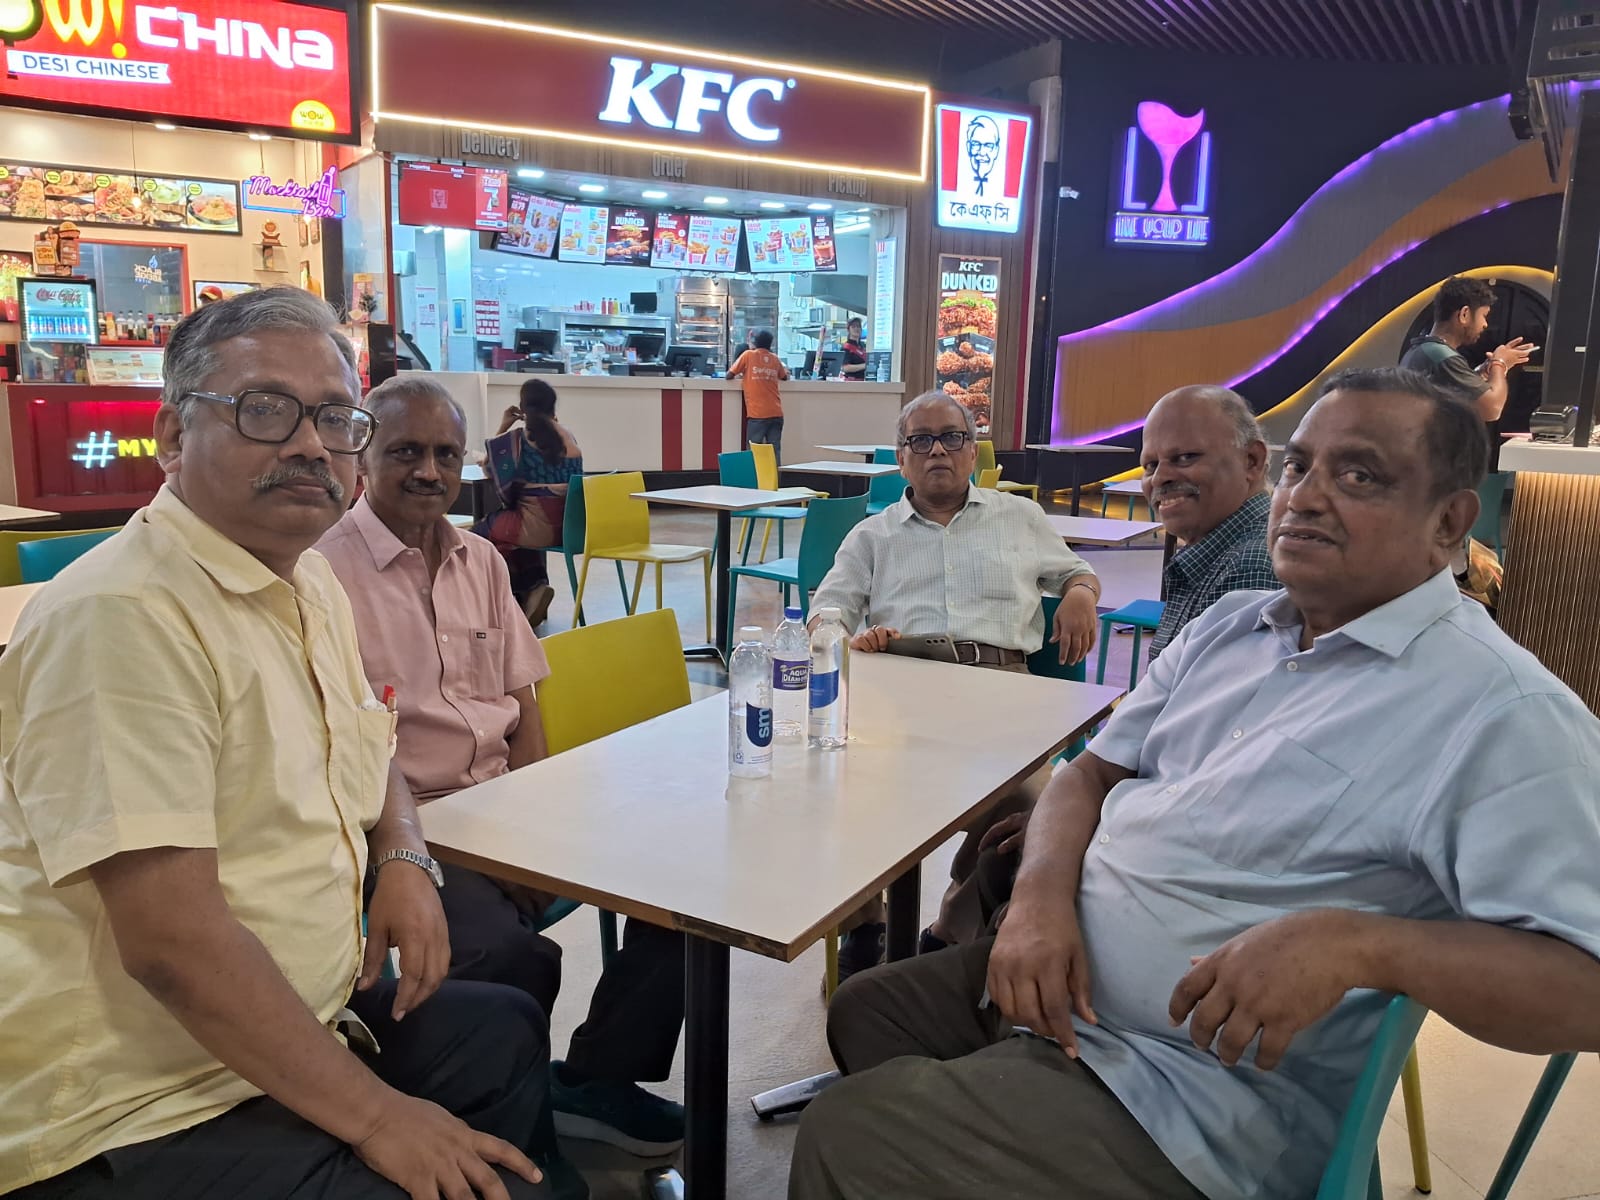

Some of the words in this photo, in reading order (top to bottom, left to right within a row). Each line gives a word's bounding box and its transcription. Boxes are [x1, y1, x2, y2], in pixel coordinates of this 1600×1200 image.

[23, 54, 69, 73] DESI
[75, 59, 160, 79] CHINESE
[597, 56, 785, 142] KFC
[461, 128, 520, 160] Delivery
[652, 151, 688, 178] Order
[249, 175, 321, 200] Mocktail
[828, 171, 867, 197] Pickup
[302, 197, 337, 217] Bar
[615, 216, 645, 227] DUNKED
[958, 260, 984, 274] KFC
[941, 272, 998, 292] DUNKED
